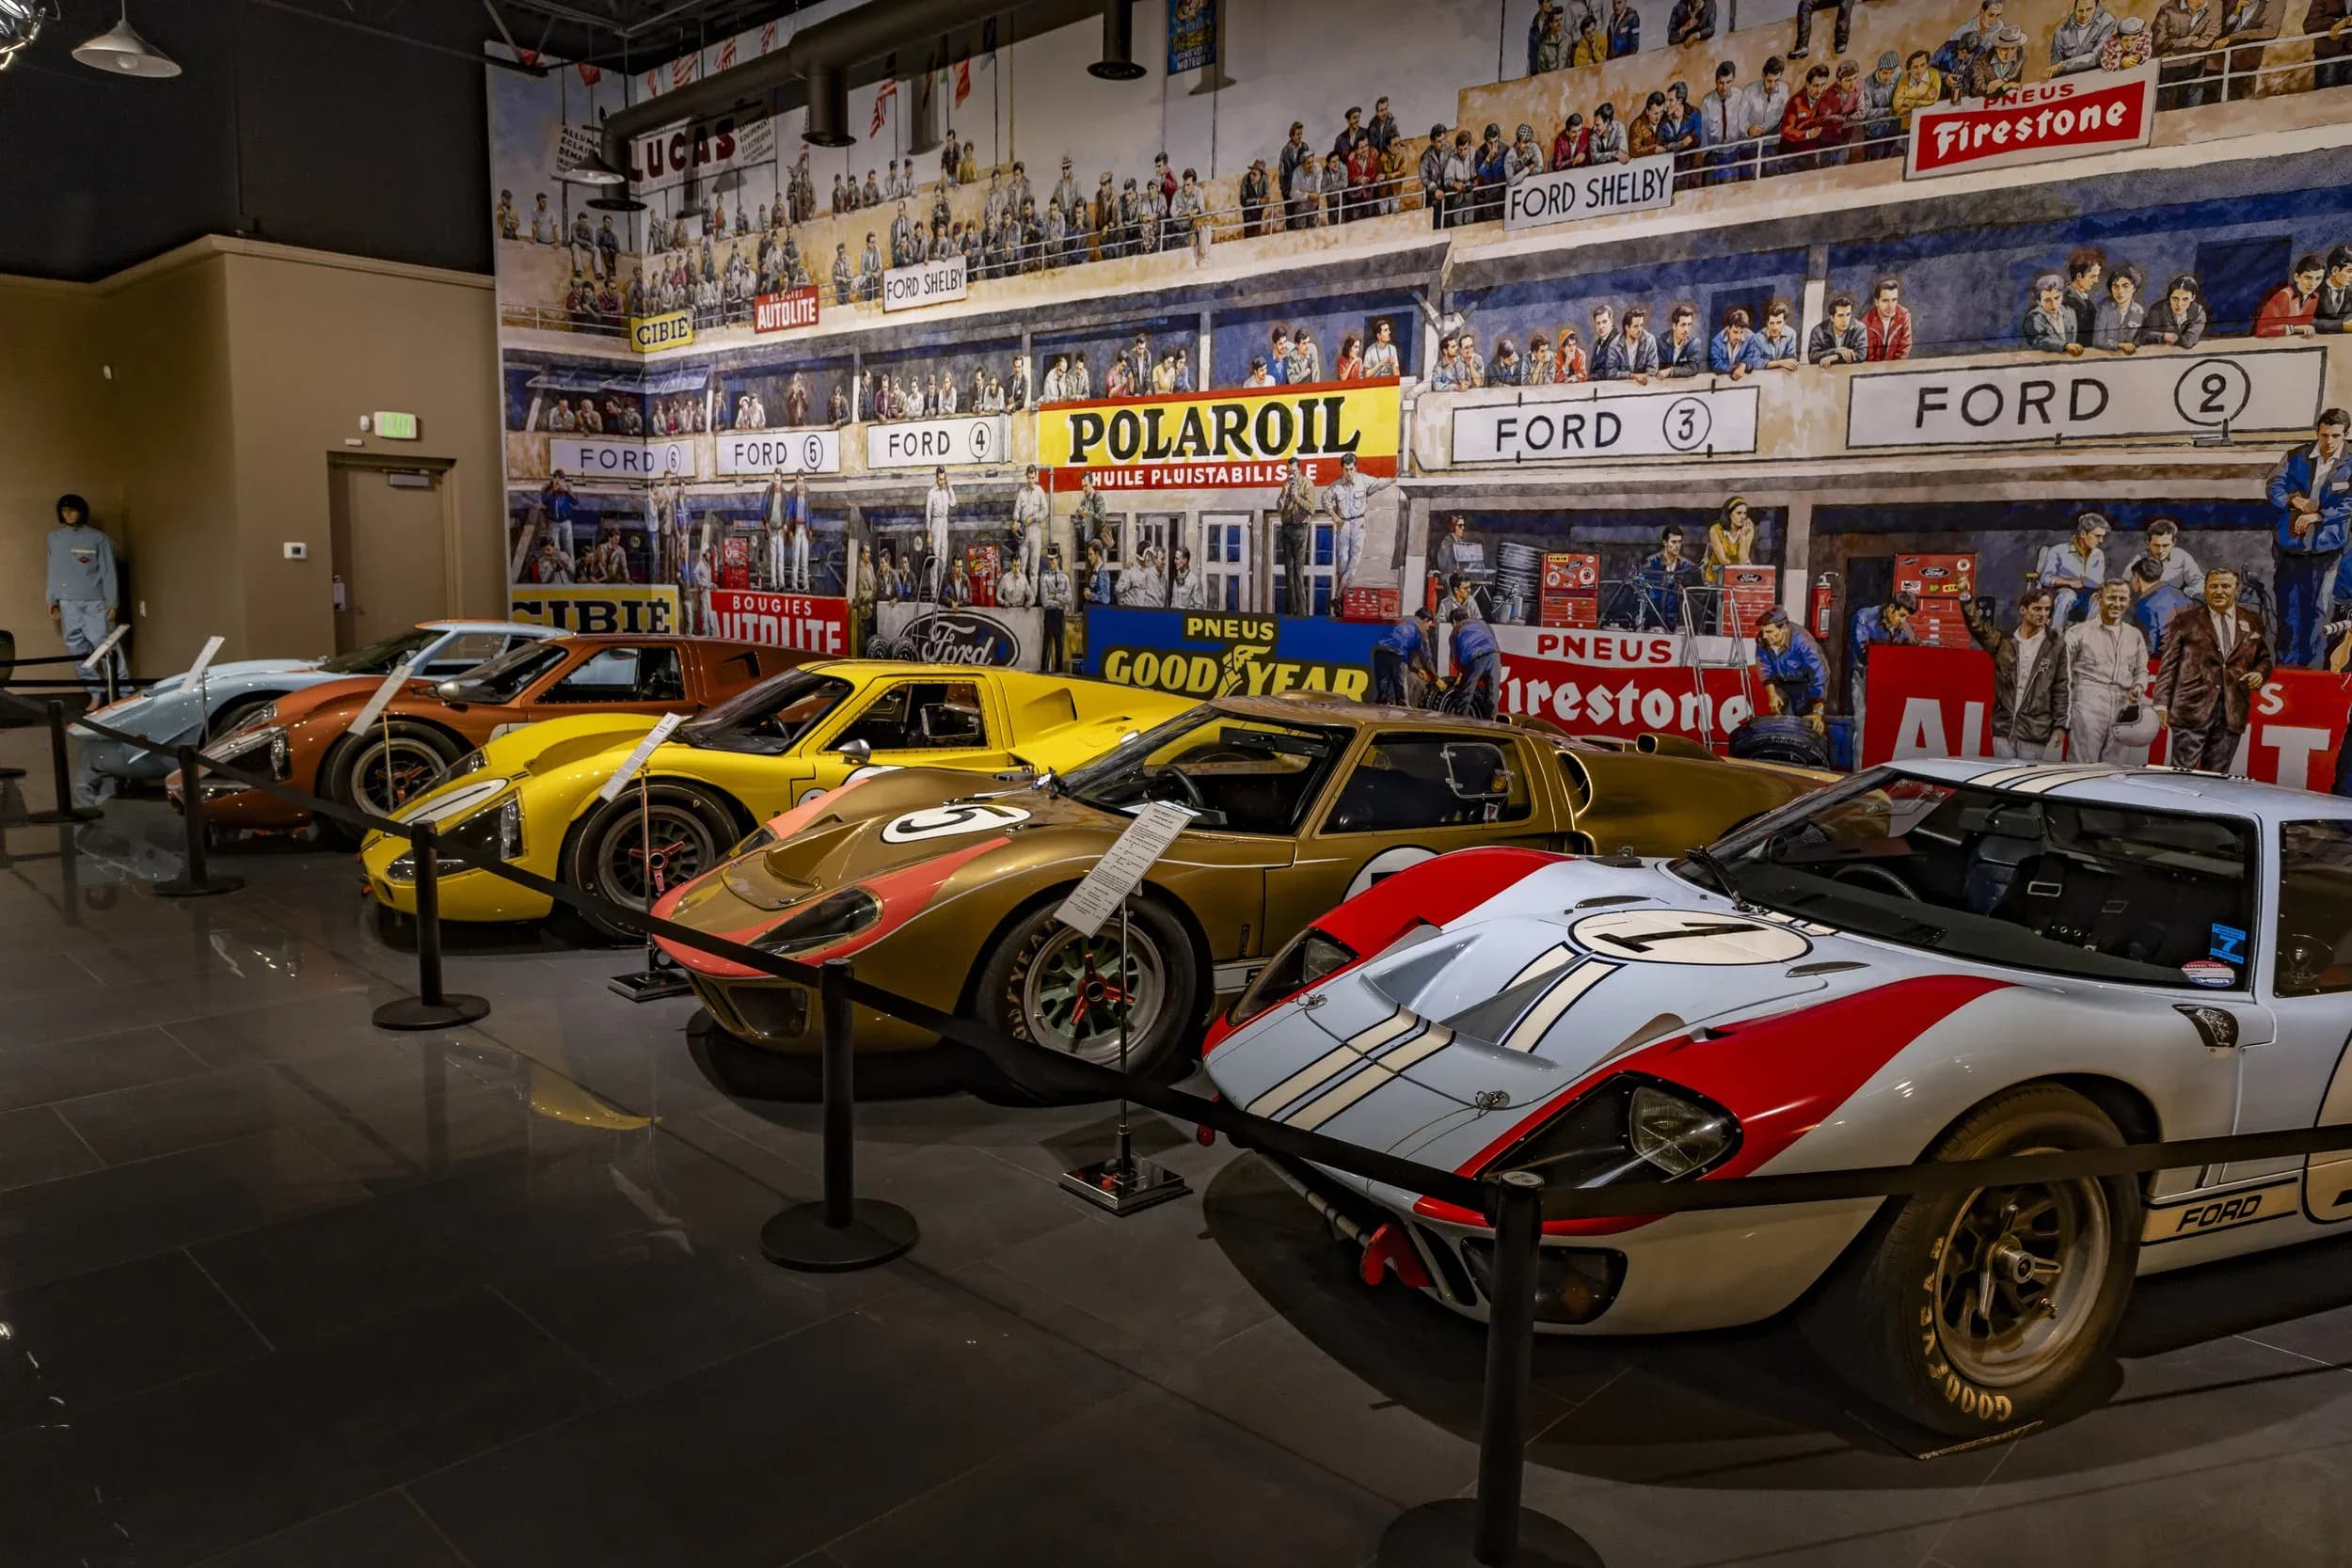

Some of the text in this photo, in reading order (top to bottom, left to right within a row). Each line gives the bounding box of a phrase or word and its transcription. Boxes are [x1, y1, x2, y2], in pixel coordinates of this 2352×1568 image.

[1983, 83, 2074, 109] PNEUS
[1932, 101, 2127, 159] Firestone
[629, 118, 736, 182] LUCAS
[1511, 166, 1669, 220] FORD SHELBY
[887, 267, 963, 301] FORD SHELBY
[757, 297, 816, 329] AUTOLITE
[1915, 373, 2227, 429] FORD 2
[889, 429, 985, 458] FORD 4
[1070, 396, 1360, 464] POLAROIL
[1496, 408, 1695, 451] FORD 3
[580, 448, 677, 471] FORD 6
[735, 442, 817, 466] FORD 5
[1092, 464, 1317, 487] HUILE PLUISTABILISE
[733, 595, 812, 616] BOUGIES
[922, 621, 993, 665] Ford
[1187, 617, 1274, 641] PNEUS
[1537, 634, 1673, 665] PNEUS
[1500, 667, 1755, 735] irestone
[896, 806, 1016, 833] 5
[1594, 922, 1770, 954] 1
[2219, 935, 2238, 952] 7
[2176, 1195, 2262, 1232] FORD
